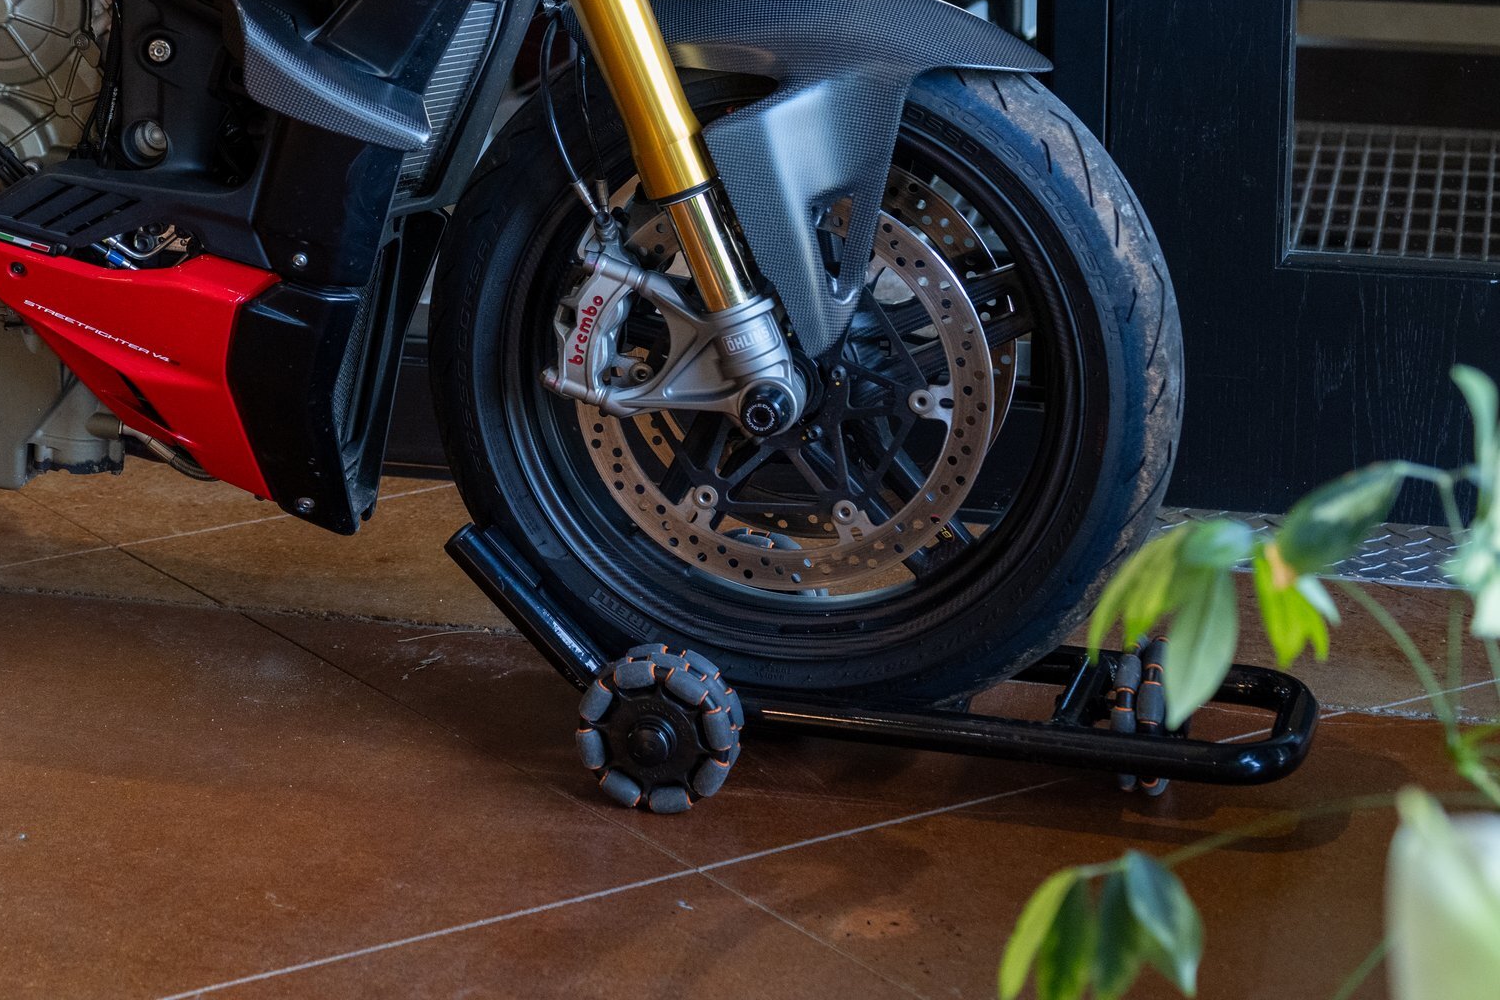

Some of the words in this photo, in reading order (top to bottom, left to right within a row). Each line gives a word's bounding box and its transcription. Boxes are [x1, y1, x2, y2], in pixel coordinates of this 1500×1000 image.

[23, 299, 150, 354] STREETFIGHTER
[152, 352, 170, 362] V4
[568, 295, 604, 366] brembo
[726, 327, 770, 352] ÖHLINS
[588, 587, 661, 643] PIRELLI
